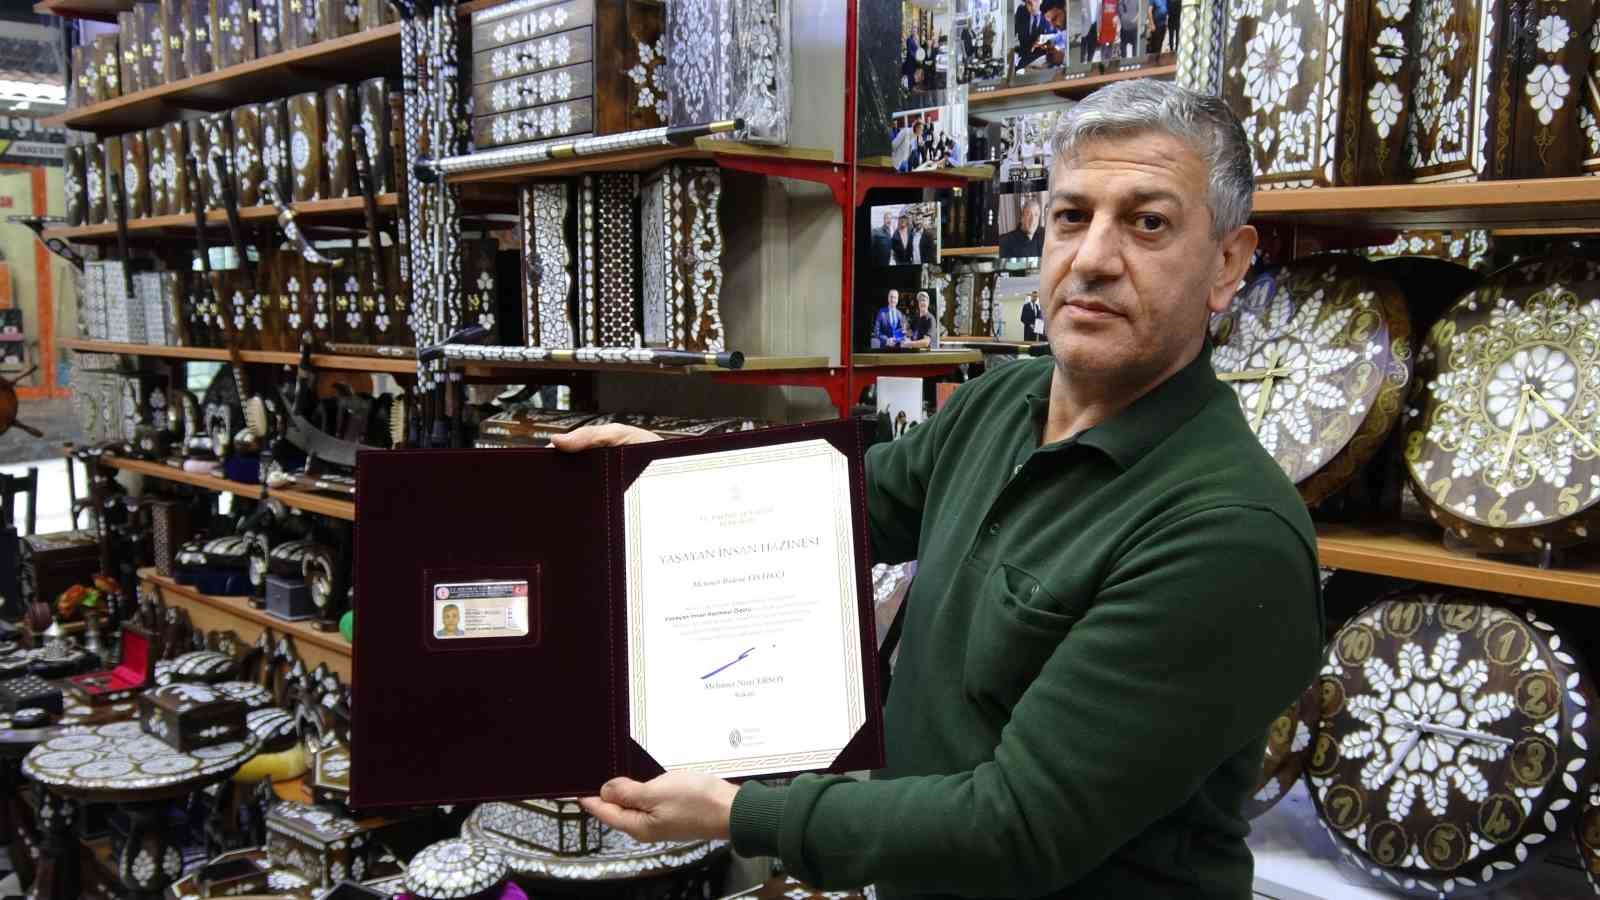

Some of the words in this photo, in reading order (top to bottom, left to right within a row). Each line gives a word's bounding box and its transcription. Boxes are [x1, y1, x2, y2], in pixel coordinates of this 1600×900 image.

[1488, 495, 1508, 526] 6
[1558, 483, 1583, 516] 5
[1389, 604, 1415, 629] 11
[1445, 604, 1473, 628] 12
[1343, 632, 1367, 661] 10
[1499, 630, 1516, 660] 1
[1527, 679, 1548, 712] 2
[1523, 744, 1547, 778] 3
[1332, 793, 1353, 822] 7
[1488, 801, 1511, 833] 4
[1378, 831, 1397, 859] 6
[1432, 830, 1456, 859] 5
